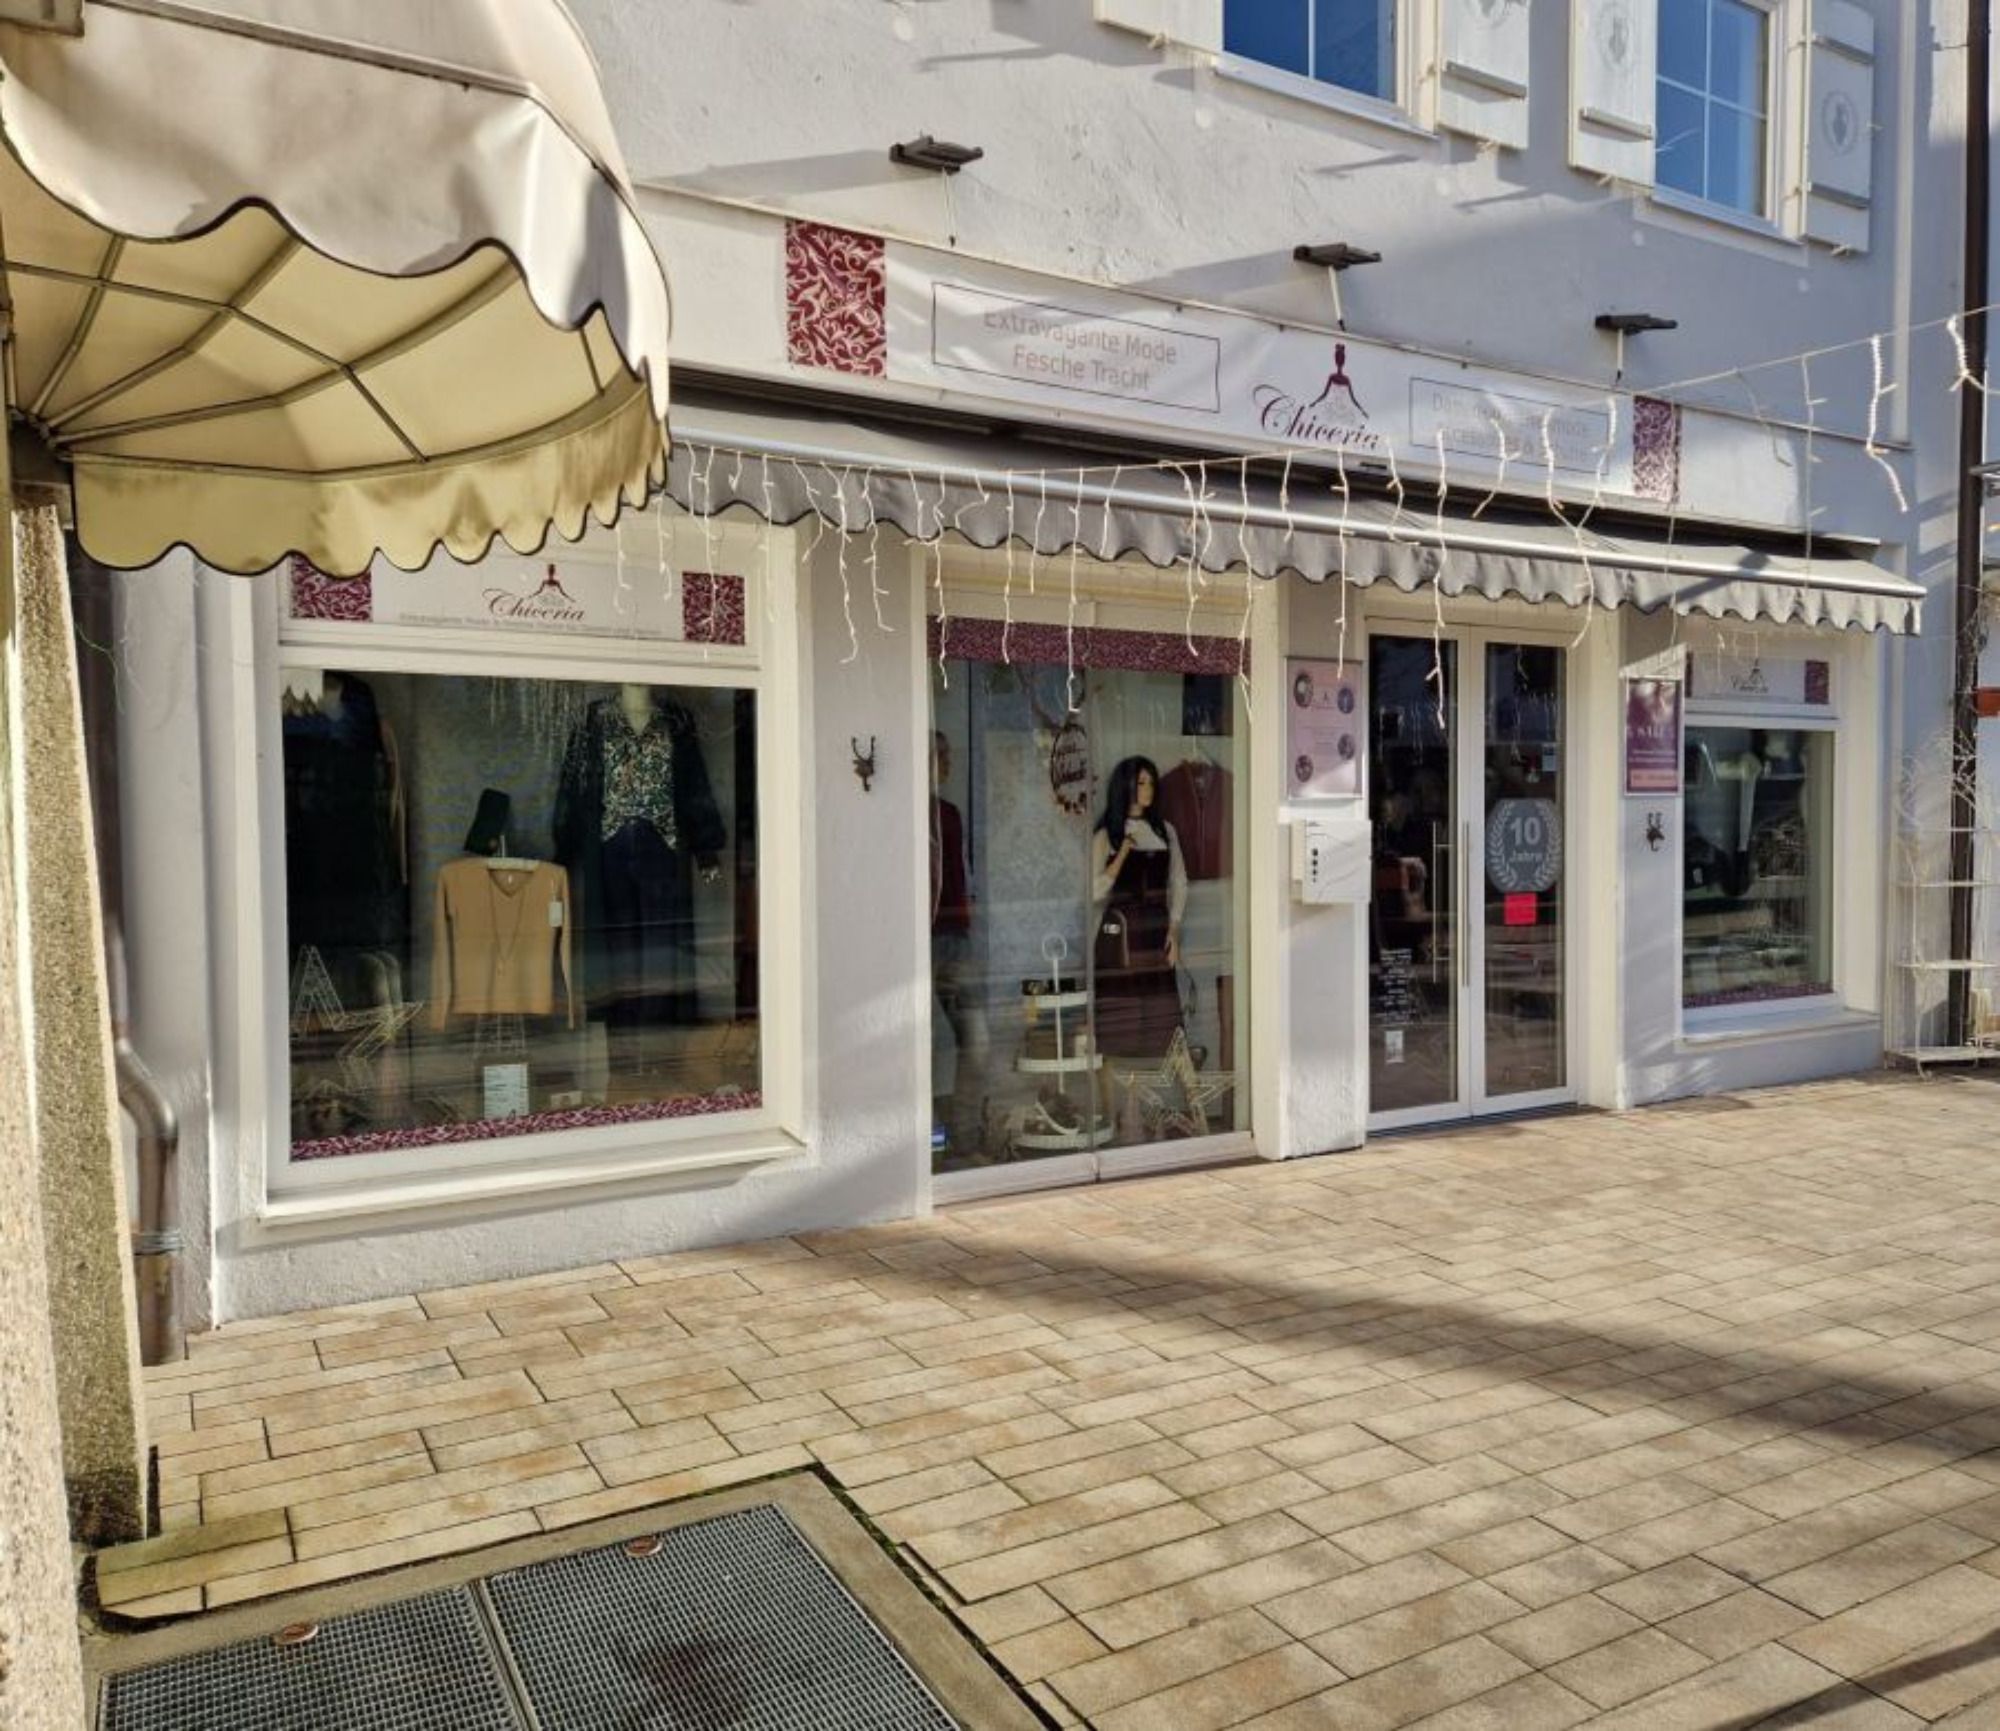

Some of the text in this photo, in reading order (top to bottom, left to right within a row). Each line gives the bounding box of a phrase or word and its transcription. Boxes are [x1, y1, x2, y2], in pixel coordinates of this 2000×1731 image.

[983, 312, 1177, 365] Extravagante Mode
[1012, 344, 1149, 391] Fesche Tracht
[1252, 384, 1379, 451] Chiceria
[482, 588, 586, 622] Chiceria
[1510, 817, 1541, 846] 10
